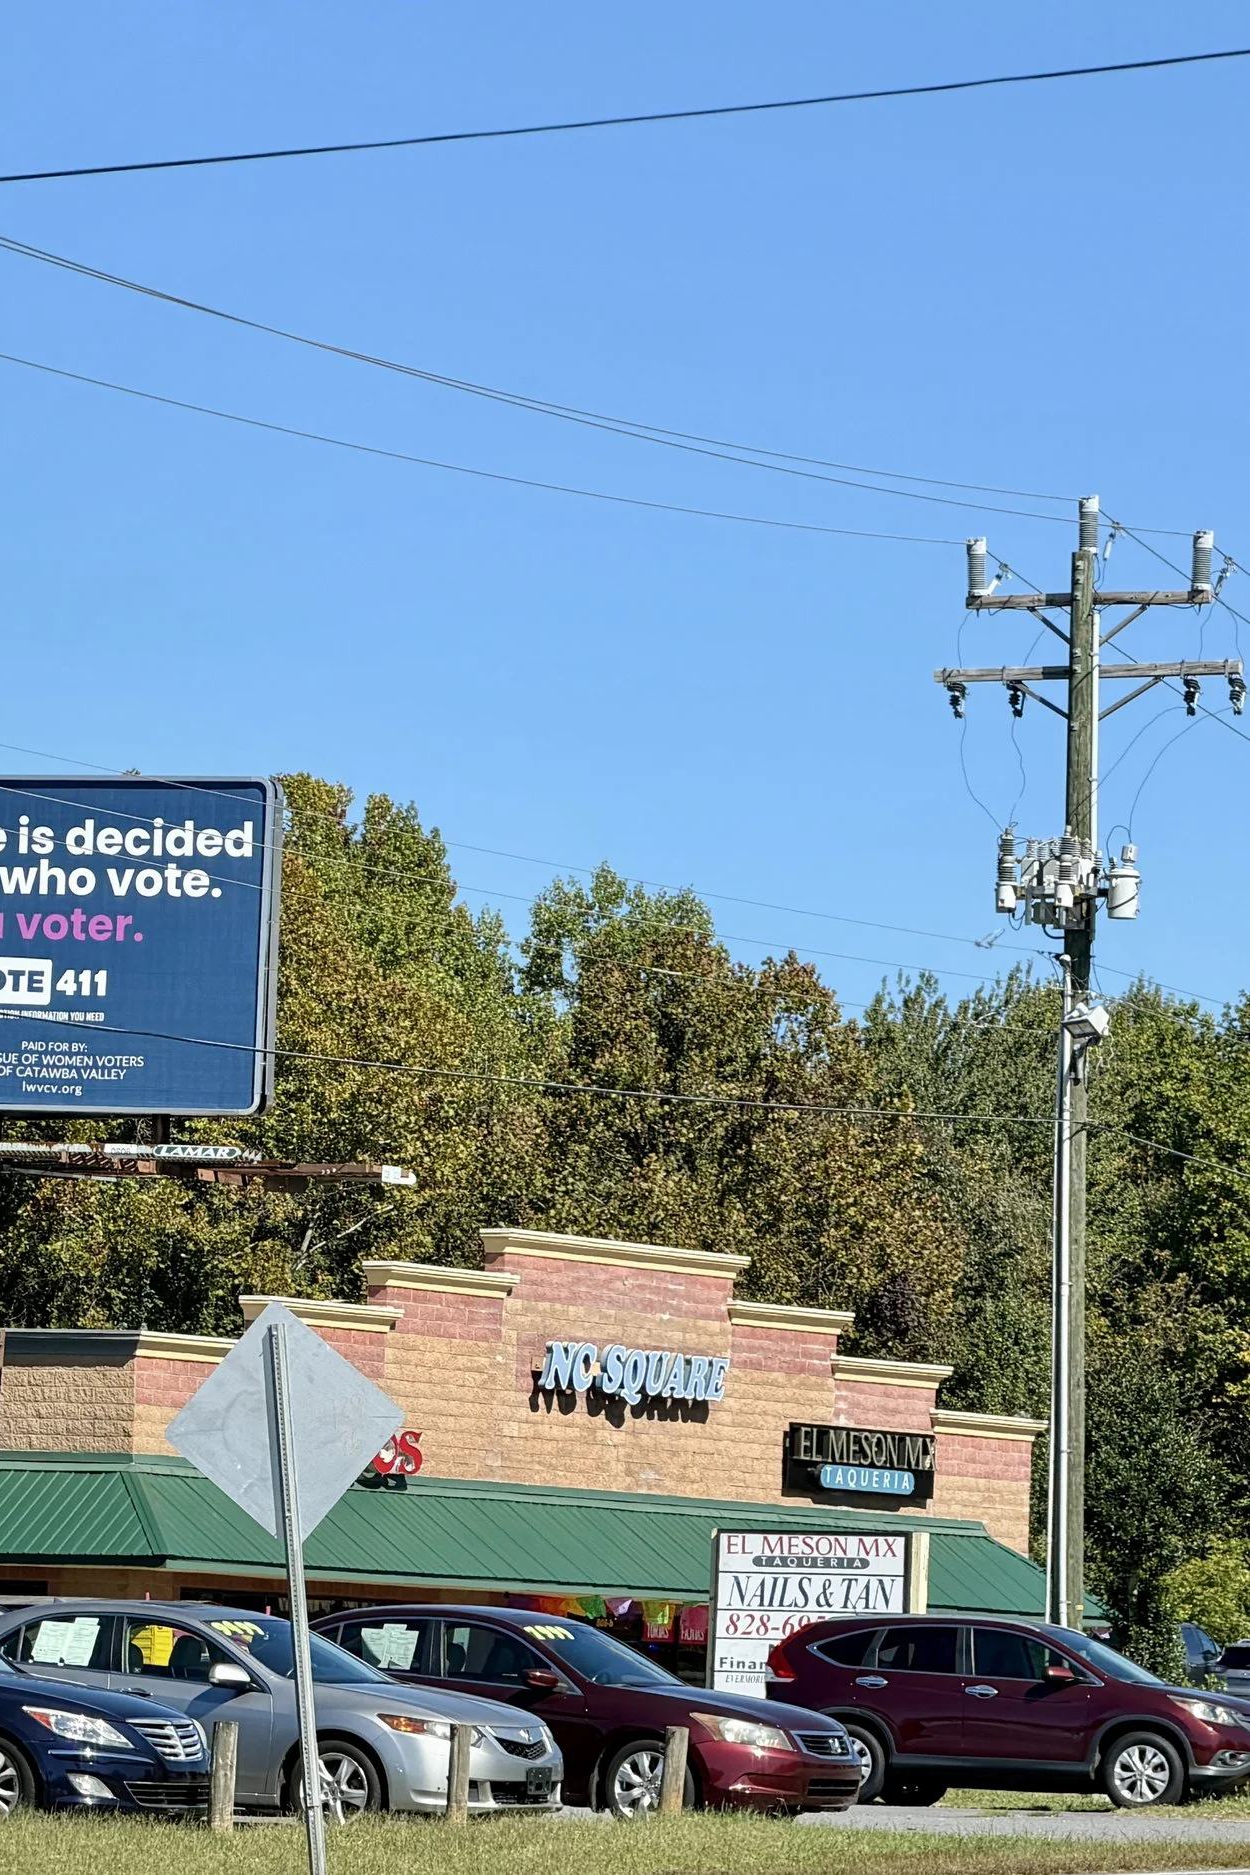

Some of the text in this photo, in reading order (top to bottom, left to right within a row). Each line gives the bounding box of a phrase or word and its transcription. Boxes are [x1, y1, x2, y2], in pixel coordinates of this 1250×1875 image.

[18, 815, 55, 855] is
[65, 817, 254, 858] decided
[107, 863, 223, 898] vote.
[16, 908, 144, 942] voter.
[56, 969, 108, 996] 411
[21, 1010, 69, 1022] INFORMATION
[70, 1012, 85, 1022] YOU
[86, 1012, 105, 1022] NEED
[21, 1041, 88, 1053] PAID FOR BY:
[22, 1054, 39, 1065] OF
[41, 1055, 94, 1067] WOMEN
[95, 1056, 145, 1067] VOTERS
[15, 1067, 78, 1079] CATAWBA
[80, 1068, 127, 1080] VALLEY
[22, 1081, 83, 1096] lwvcv.org
[161, 1145, 230, 1158] LAMAR
[538, 1341, 730, 1405] NC SQUARE
[799, 1427, 938, 1471] EL MESON MX
[825, 1466, 910, 1490] TAQUERIA
[726, 1535, 897, 1558] EL MESON MX
[761, 1557, 862, 1568] TAQUERIA
[726, 1575, 897, 1610] NAILS & TAN
